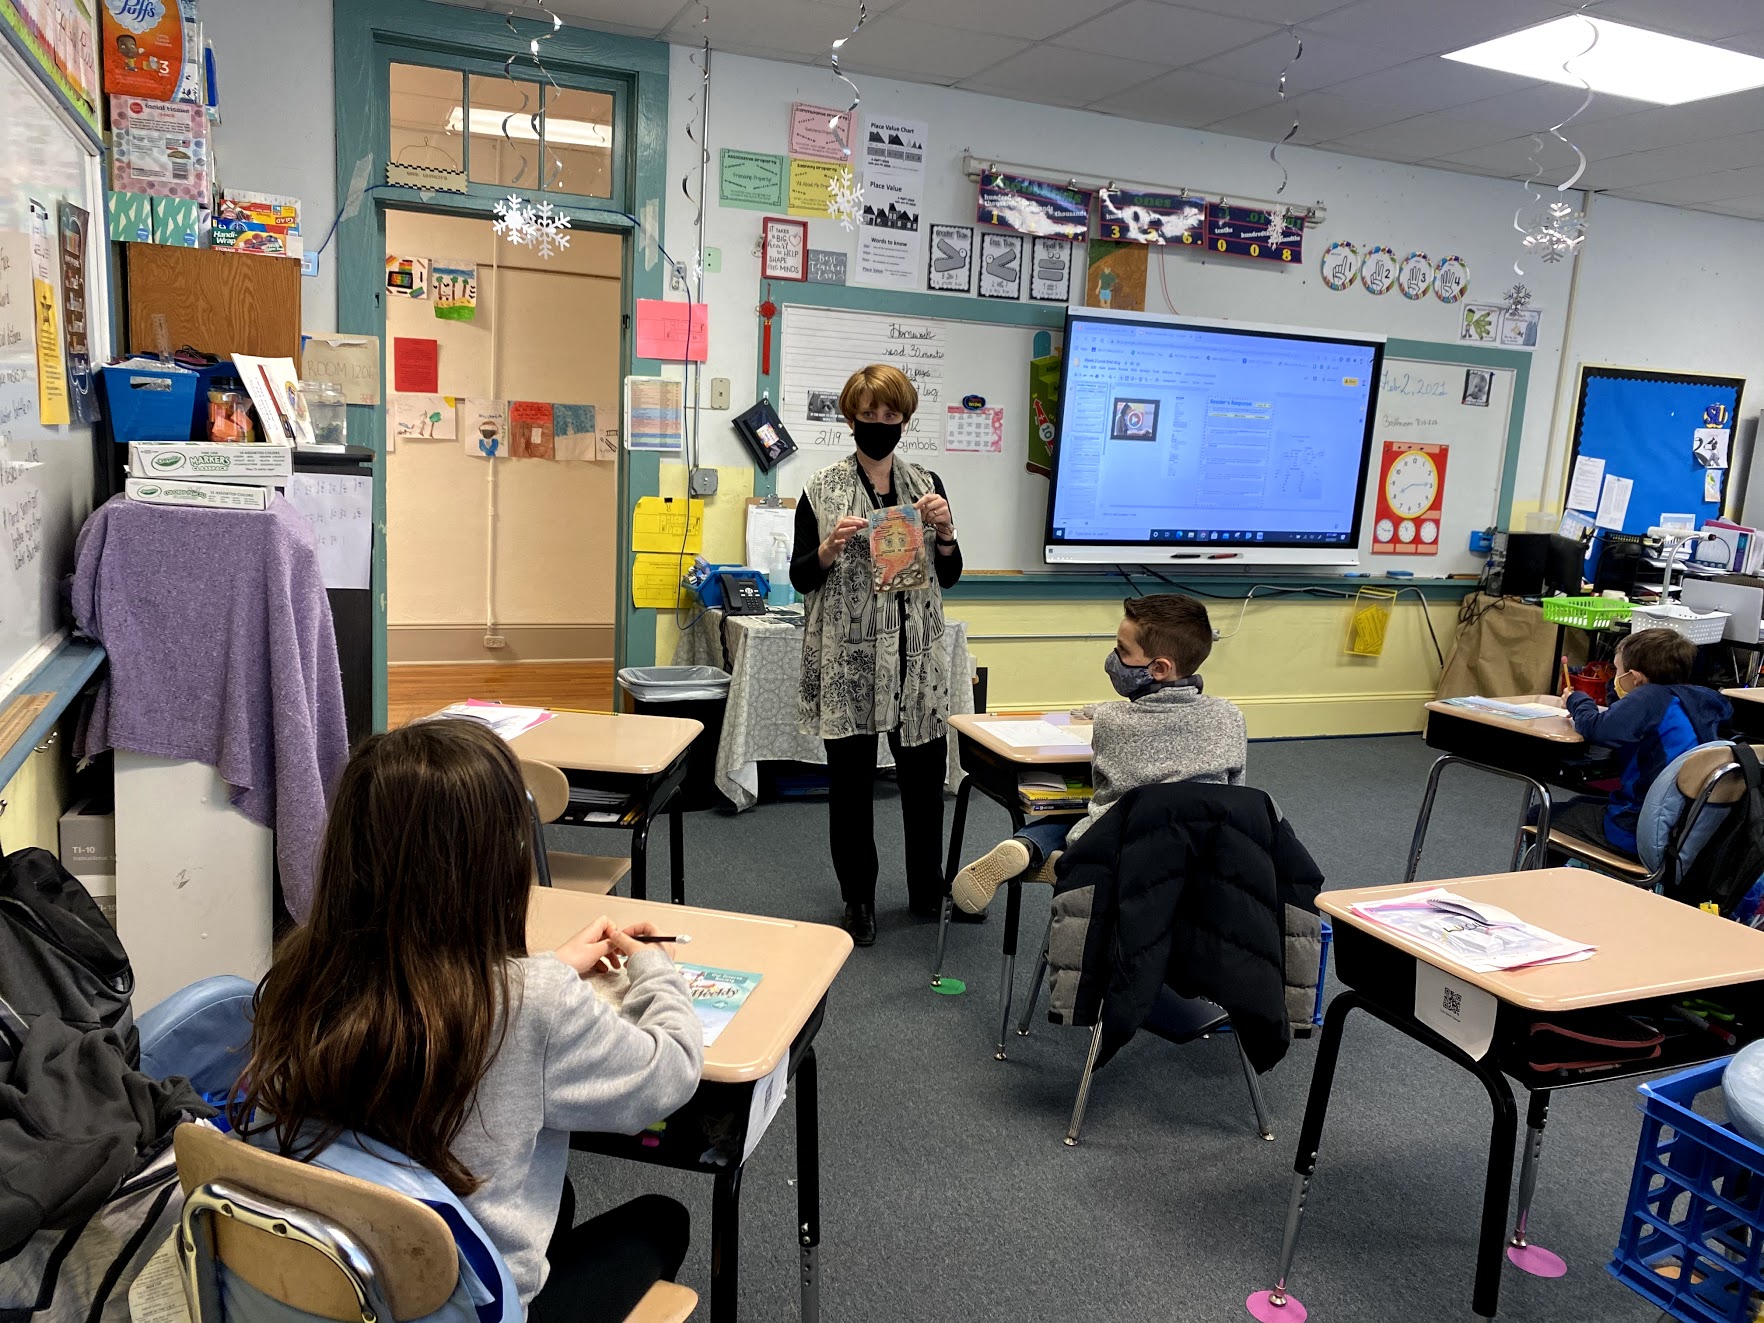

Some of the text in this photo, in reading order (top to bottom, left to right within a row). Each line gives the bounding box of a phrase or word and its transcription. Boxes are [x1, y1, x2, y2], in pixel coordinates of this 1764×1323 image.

[159, 60, 170, 74] 3
[145, 103, 190, 114] facial tissue
[870, 122, 915, 134] Place Value Chart
[870, 180, 903, 193] Place Value
[1134, 196, 1172, 208] ones
[991, 210, 999, 225] 1
[213, 230, 238, 238] Handi-
[935, 229, 969, 240] Greater Than
[1111, 225, 1121, 239] 3
[216, 237, 236, 246] Wrap
[767, 239, 789, 250] heart
[776, 235, 787, 243] BIG
[871, 237, 887, 245] Words
[989, 237, 1017, 248] Less Than
[1042, 241, 1057, 251] Equal
[1217, 239, 1292, 261] 0 0 8
[769, 256, 787, 264] SHAPE
[818, 253, 837, 264] Best
[779, 265, 800, 274] MINDS
[808, 261, 845, 275] Teacher
[1384, 268, 1391, 279] 2
[817, 270, 836, 279] Ever
[1420, 272, 1427, 283] 3
[1454, 276, 1461, 287] 4
[888, 323, 936, 340] Homework
[881, 344, 906, 357] read
[908, 344, 920, 358] 30
[306, 360, 347, 378] ROOM
[1380, 370, 1400, 393] Feb
[922, 382, 940, 402] log
[814, 428, 842, 447] 2/19
[1041, 424, 1053, 440] 10
[189, 455, 232, 467] MARKERS
[72, 846, 96, 854] TI-10
[692, 987, 739, 999] Weekly
